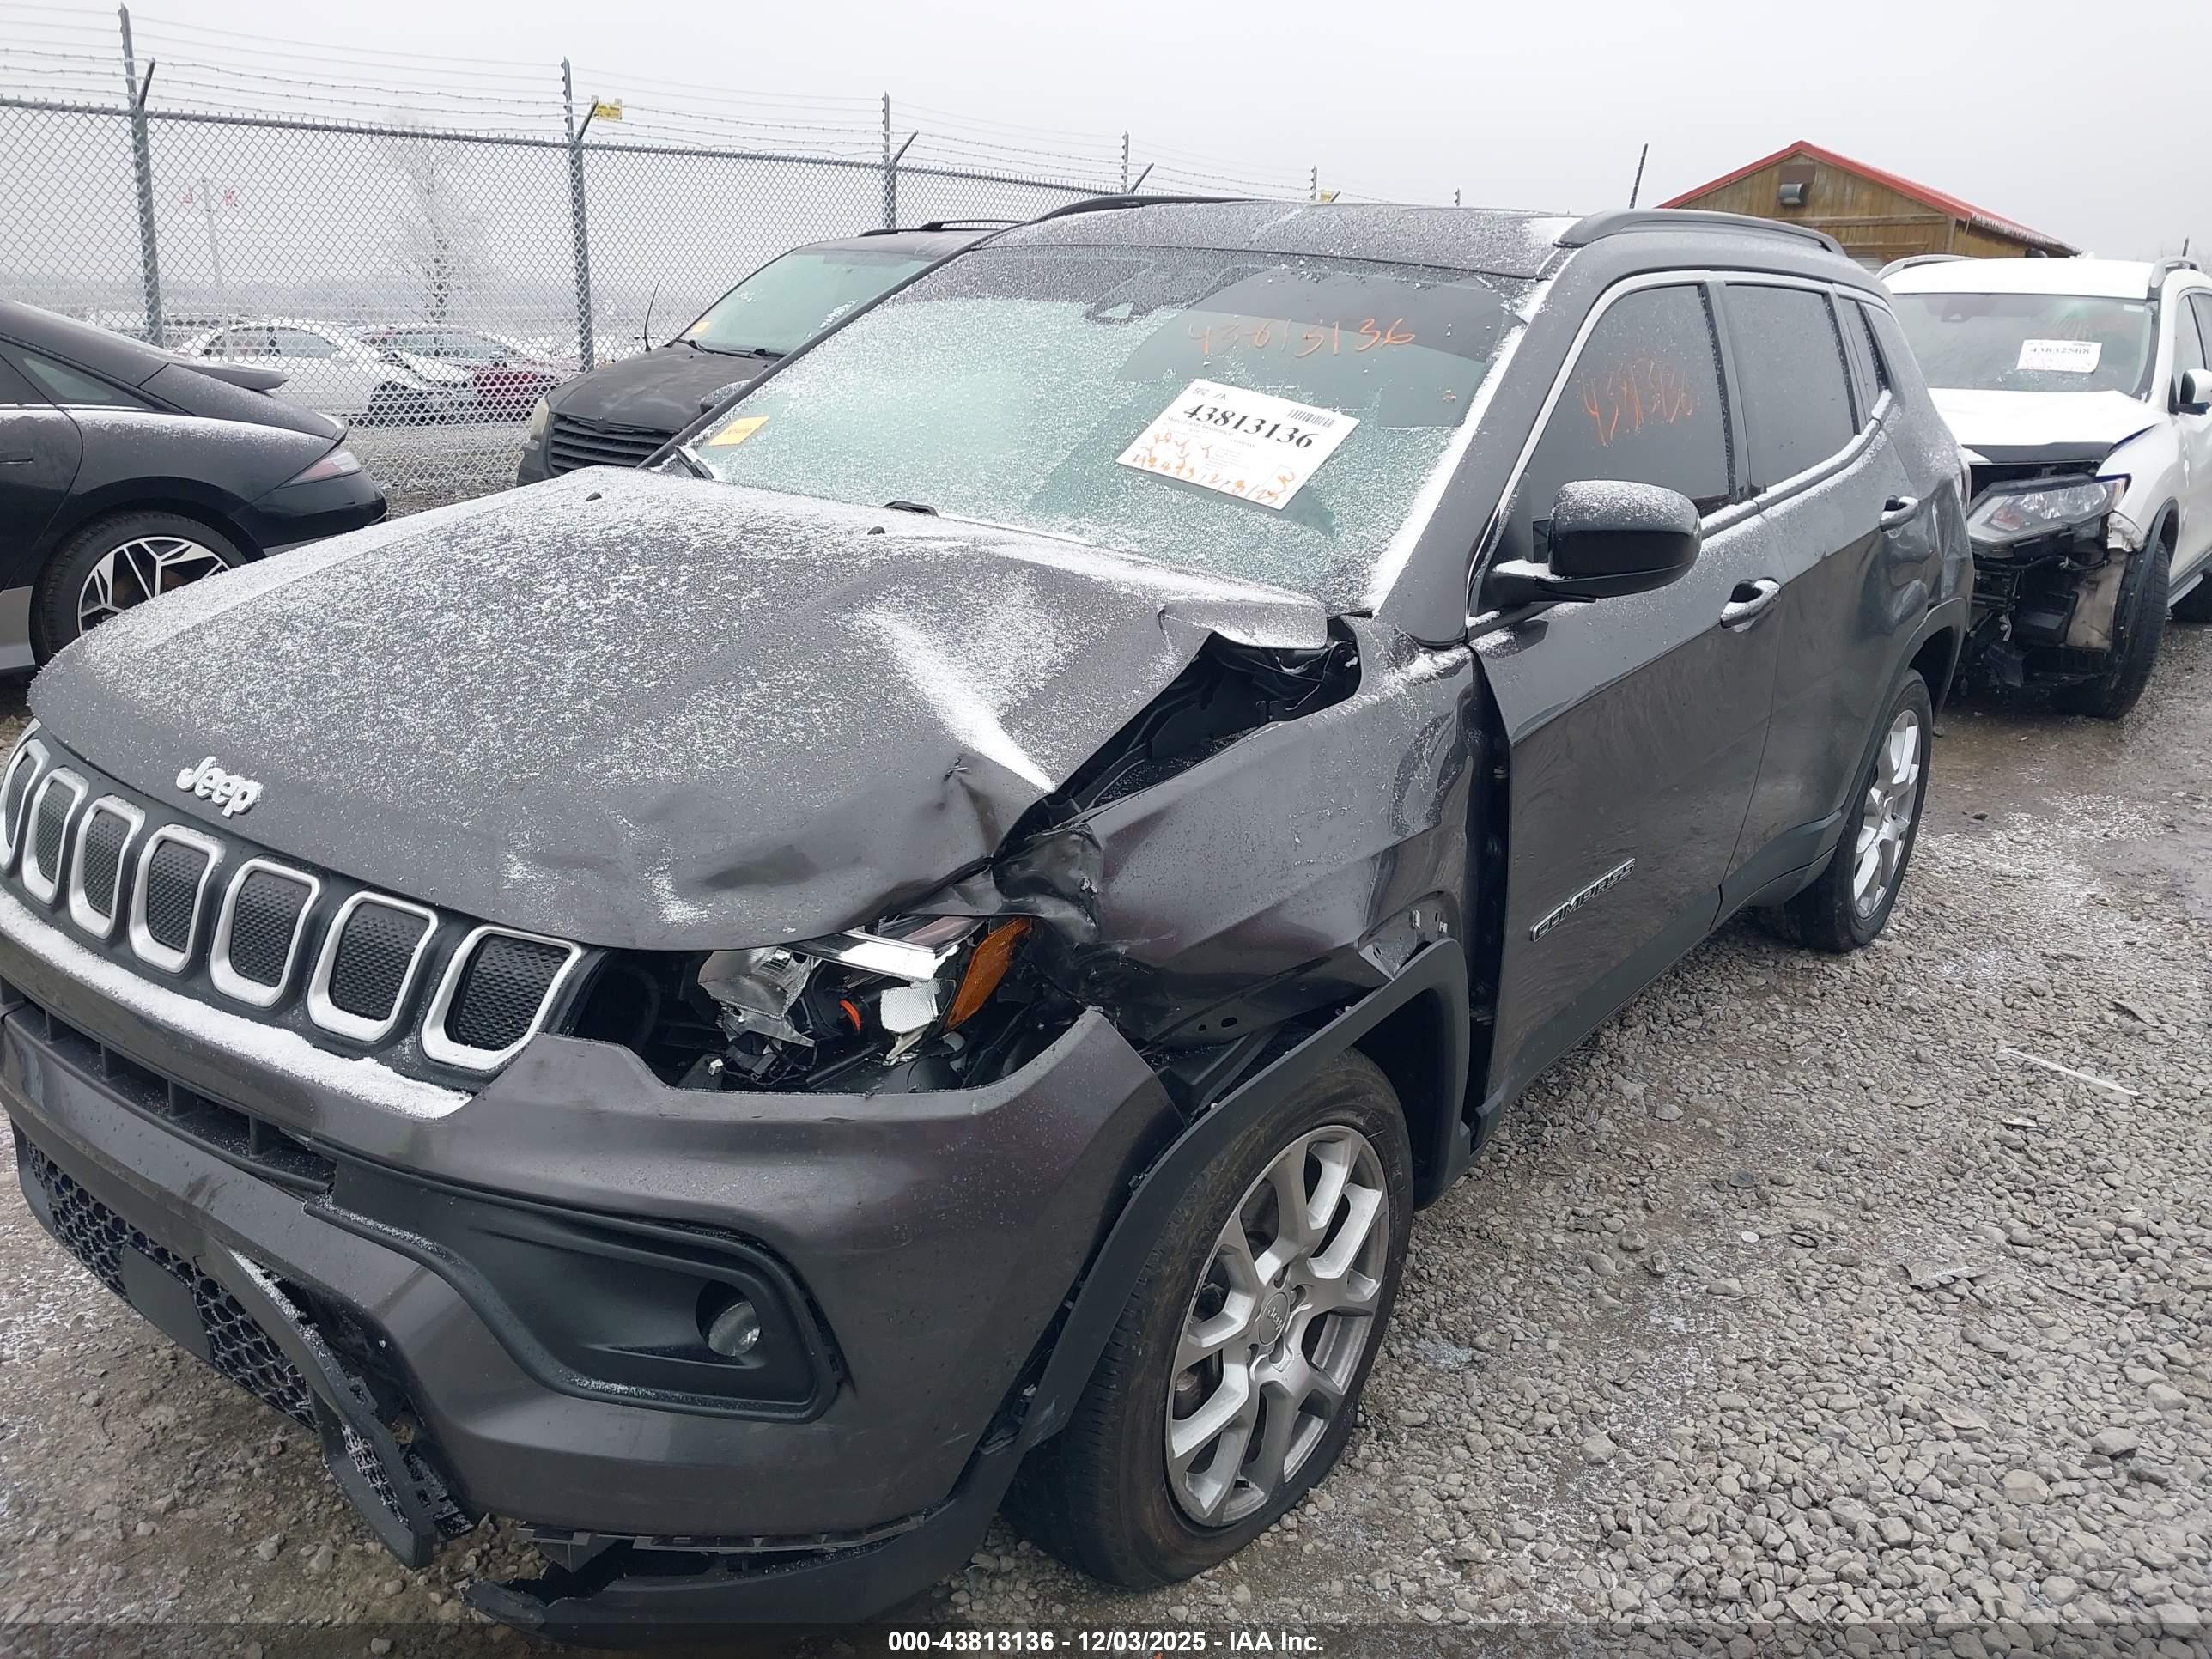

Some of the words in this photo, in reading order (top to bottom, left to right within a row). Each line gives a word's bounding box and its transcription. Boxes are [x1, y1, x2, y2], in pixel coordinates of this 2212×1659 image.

[1183, 404, 1320, 448] 43813136
[176, 756, 264, 818] Jeep
[1530, 858, 1636, 942] COMPASS
[1267, 1306, 1283, 1330] Jeep
